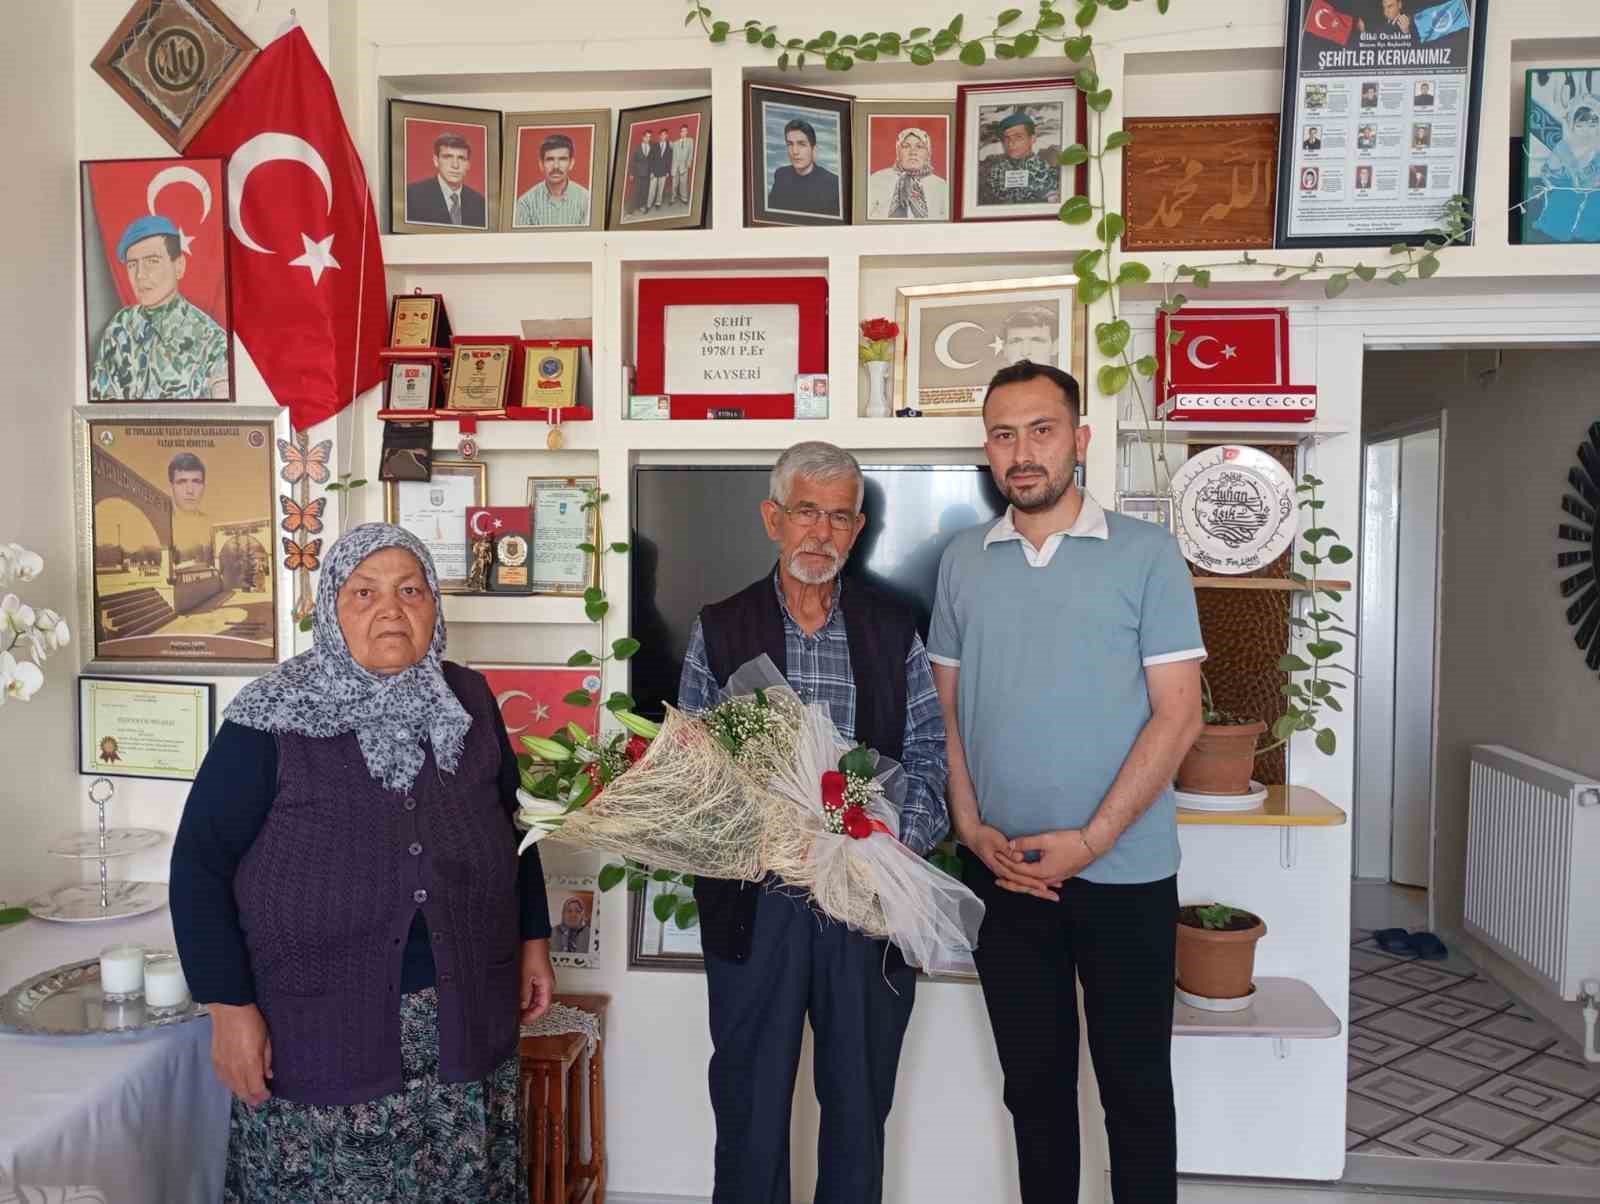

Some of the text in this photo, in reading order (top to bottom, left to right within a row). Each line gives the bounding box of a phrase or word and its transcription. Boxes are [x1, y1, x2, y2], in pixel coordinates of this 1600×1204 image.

[1318, 48, 1452, 69] ŞEHİTLER KERVANIMIZ
[713, 315, 752, 328] ŞEHİT
[700, 330, 766, 343] Ayhan IŞIK
[701, 345, 764, 356] 1978/1 P.Er
[703, 366, 761, 380] KAYSERİ
